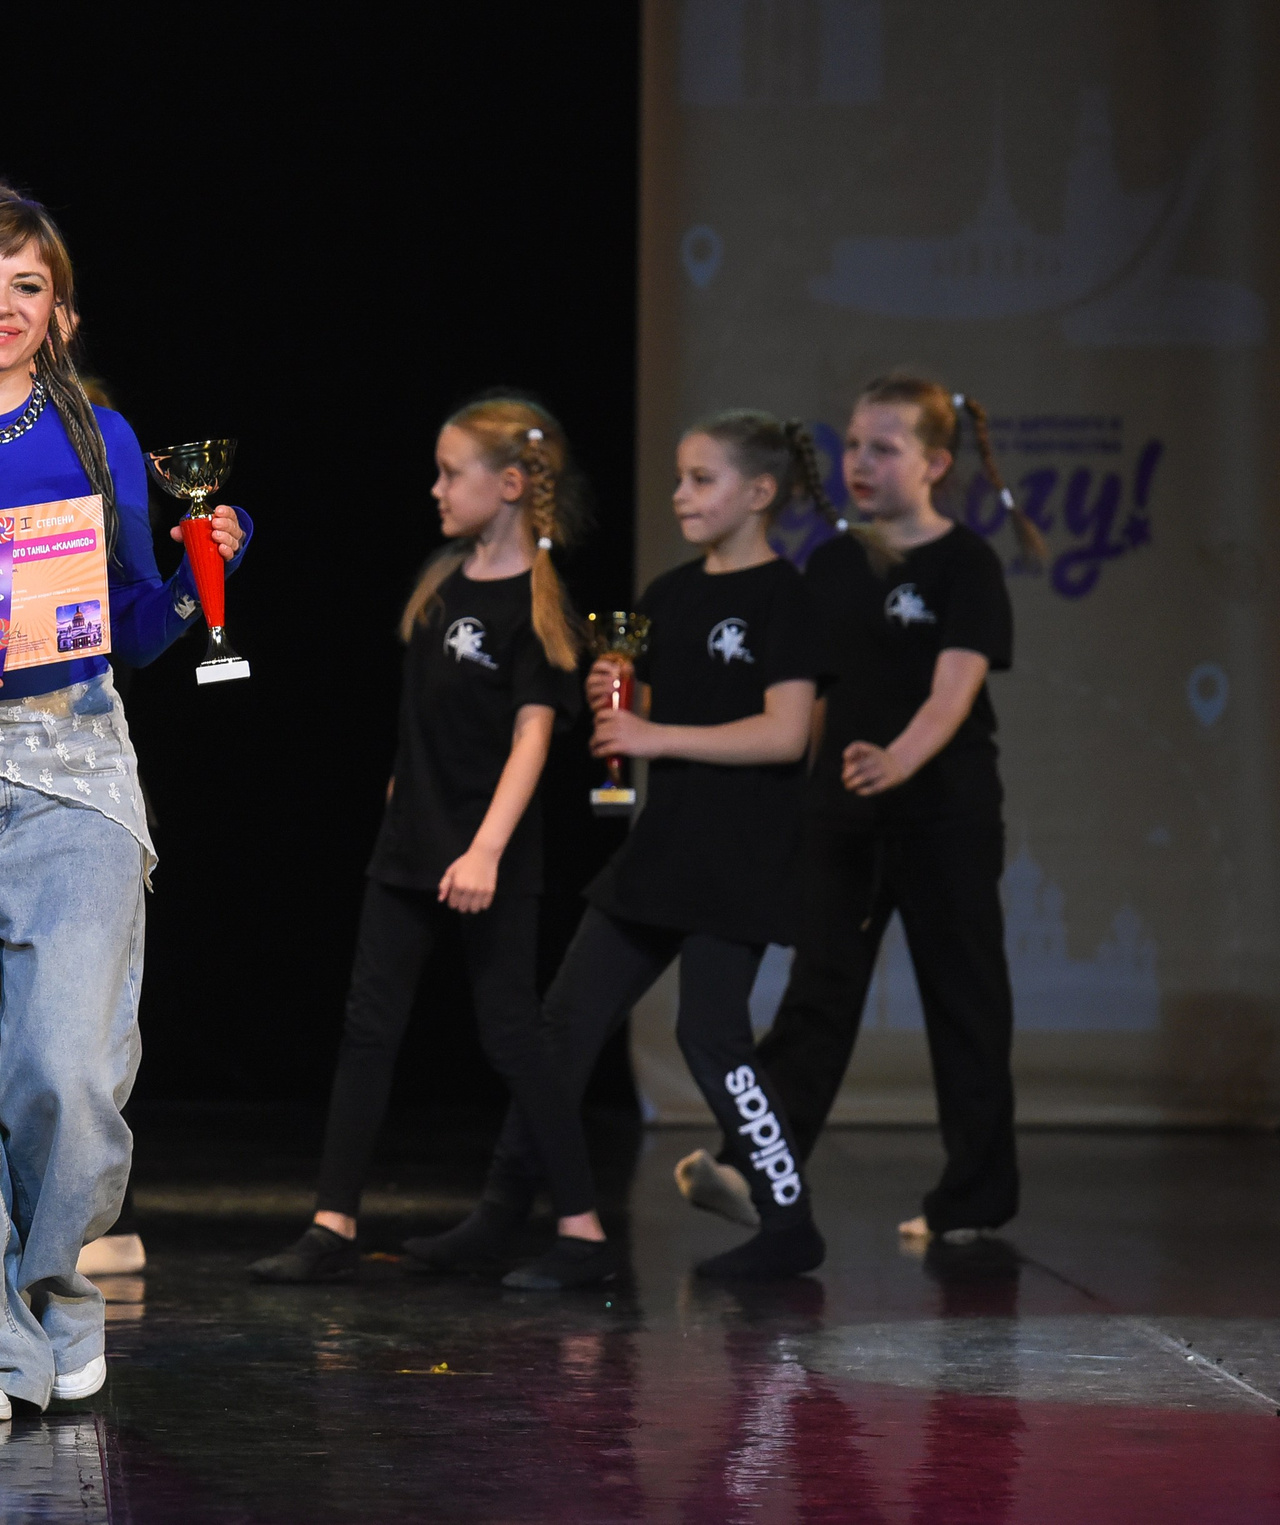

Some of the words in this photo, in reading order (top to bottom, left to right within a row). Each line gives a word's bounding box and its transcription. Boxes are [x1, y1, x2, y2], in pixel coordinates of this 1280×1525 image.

[12, 548, 26, 558] ОГО
[26, 544, 51, 556] ТАНЦА
[51, 537, 95, 551] «КАЛИПСО»
[36, 514, 75, 529] СТЕПЕНИ
[967, 439, 1163, 597] огу!
[724, 1064, 802, 1207] adidas
